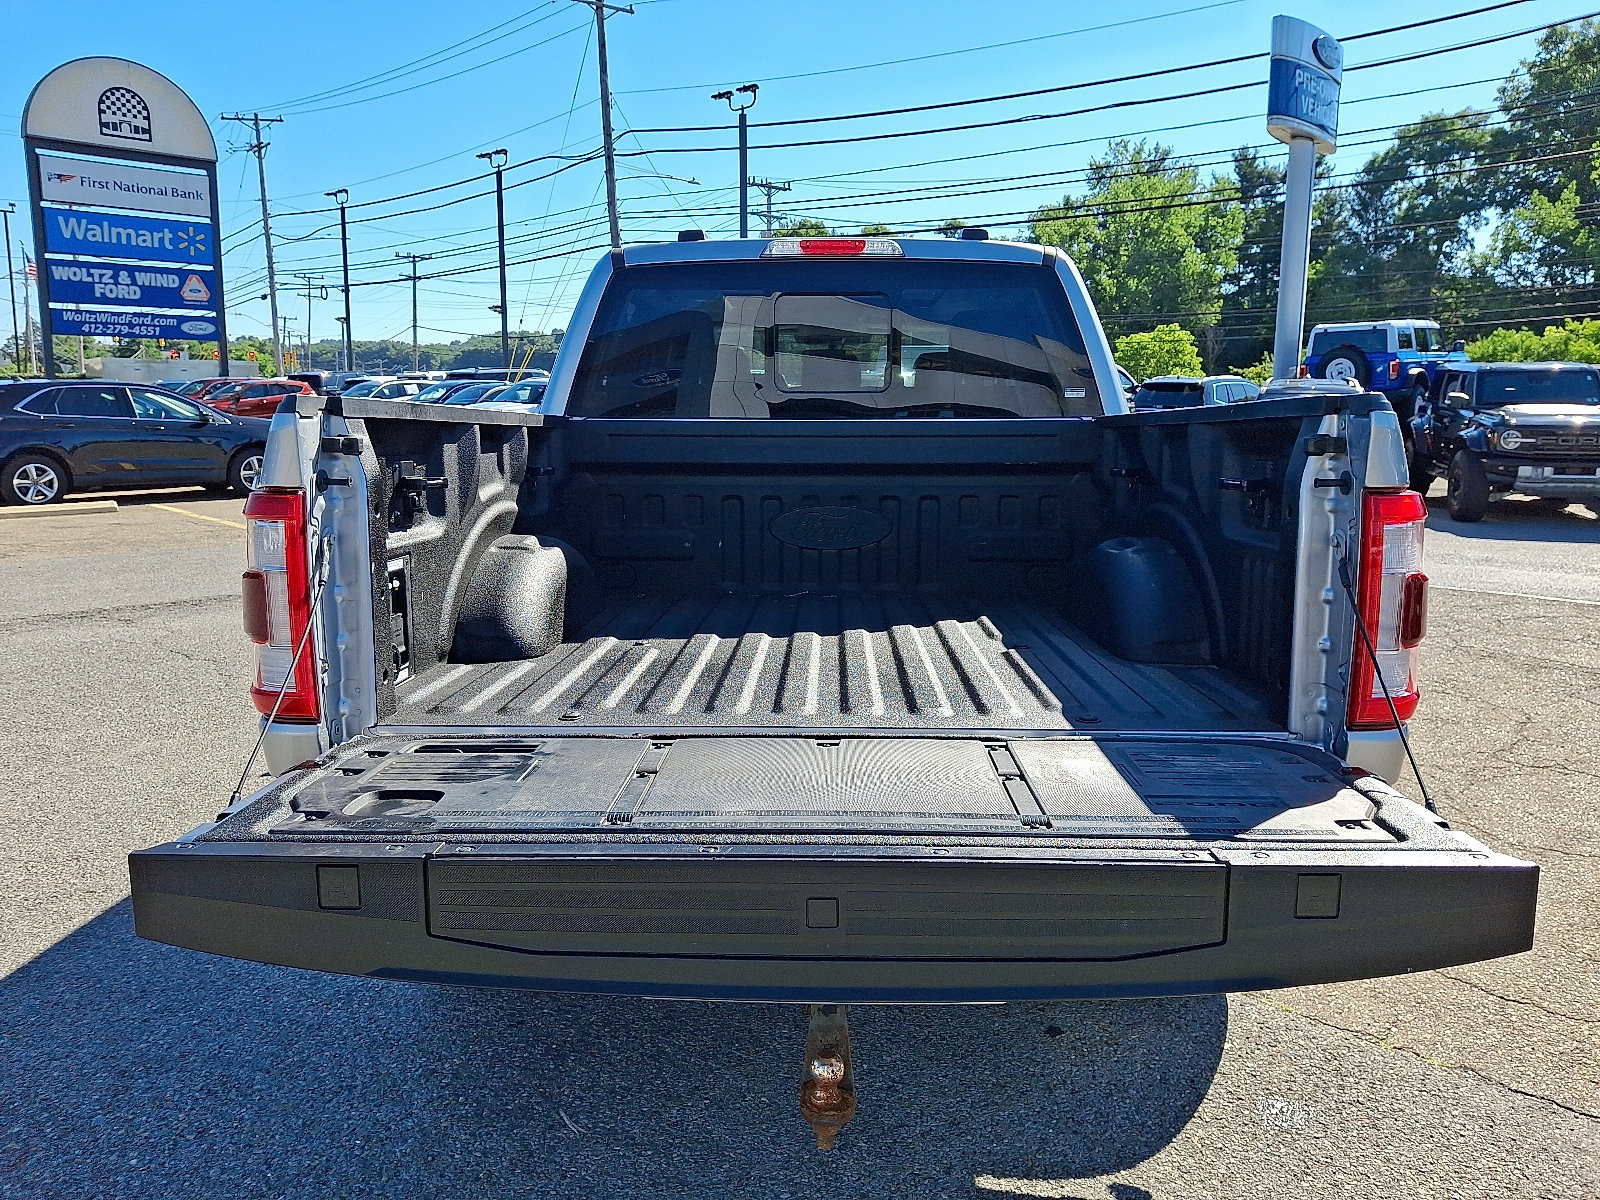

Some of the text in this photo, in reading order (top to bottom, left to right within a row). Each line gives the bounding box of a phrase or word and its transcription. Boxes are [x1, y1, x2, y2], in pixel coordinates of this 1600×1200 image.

[80, 175, 204, 201] First National Bank
[57, 215, 173, 250] Walmart
[51, 265, 180, 288] WOLTZ & WIND
[94, 284, 141, 300] FORD
[62, 311, 178, 326] WoltzWindFord.com
[81, 324, 160, 336] 412-279-4551
[1537, 435, 1600, 447] FOR
